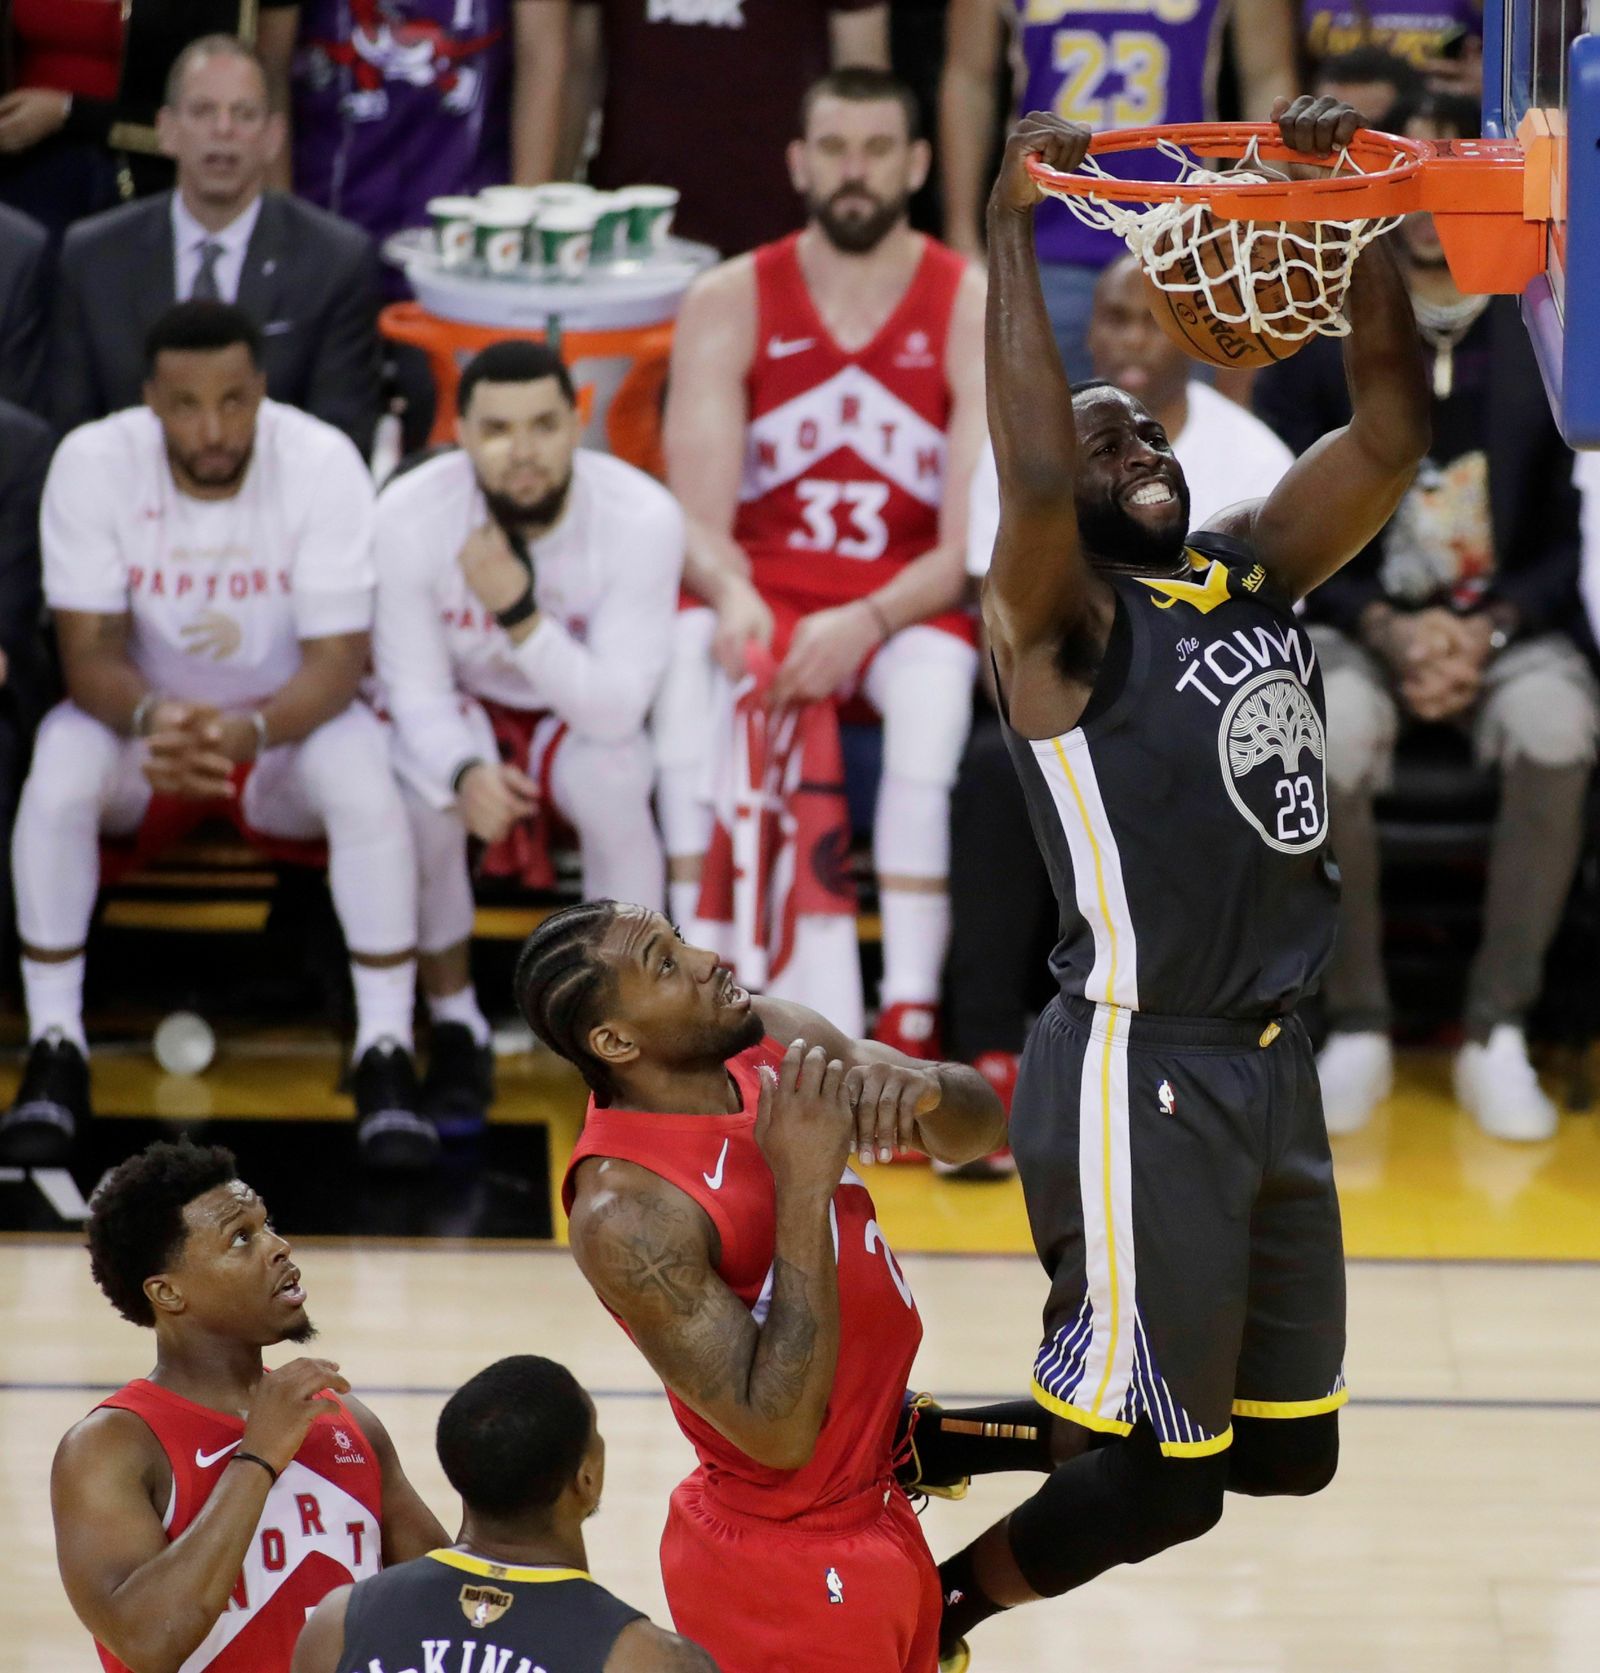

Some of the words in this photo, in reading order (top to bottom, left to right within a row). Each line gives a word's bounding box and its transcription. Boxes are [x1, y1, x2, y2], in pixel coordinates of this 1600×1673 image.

[1051, 29, 1169, 131] 23
[757, 394, 940, 479] NORTH
[787, 479, 889, 561] 33
[1175, 637, 1200, 662] The
[1175, 620, 1316, 706] TOWN
[1275, 775, 1319, 840] 23
[334, 1454, 352, 1464] Sun
[351, 1454, 366, 1464] Life
